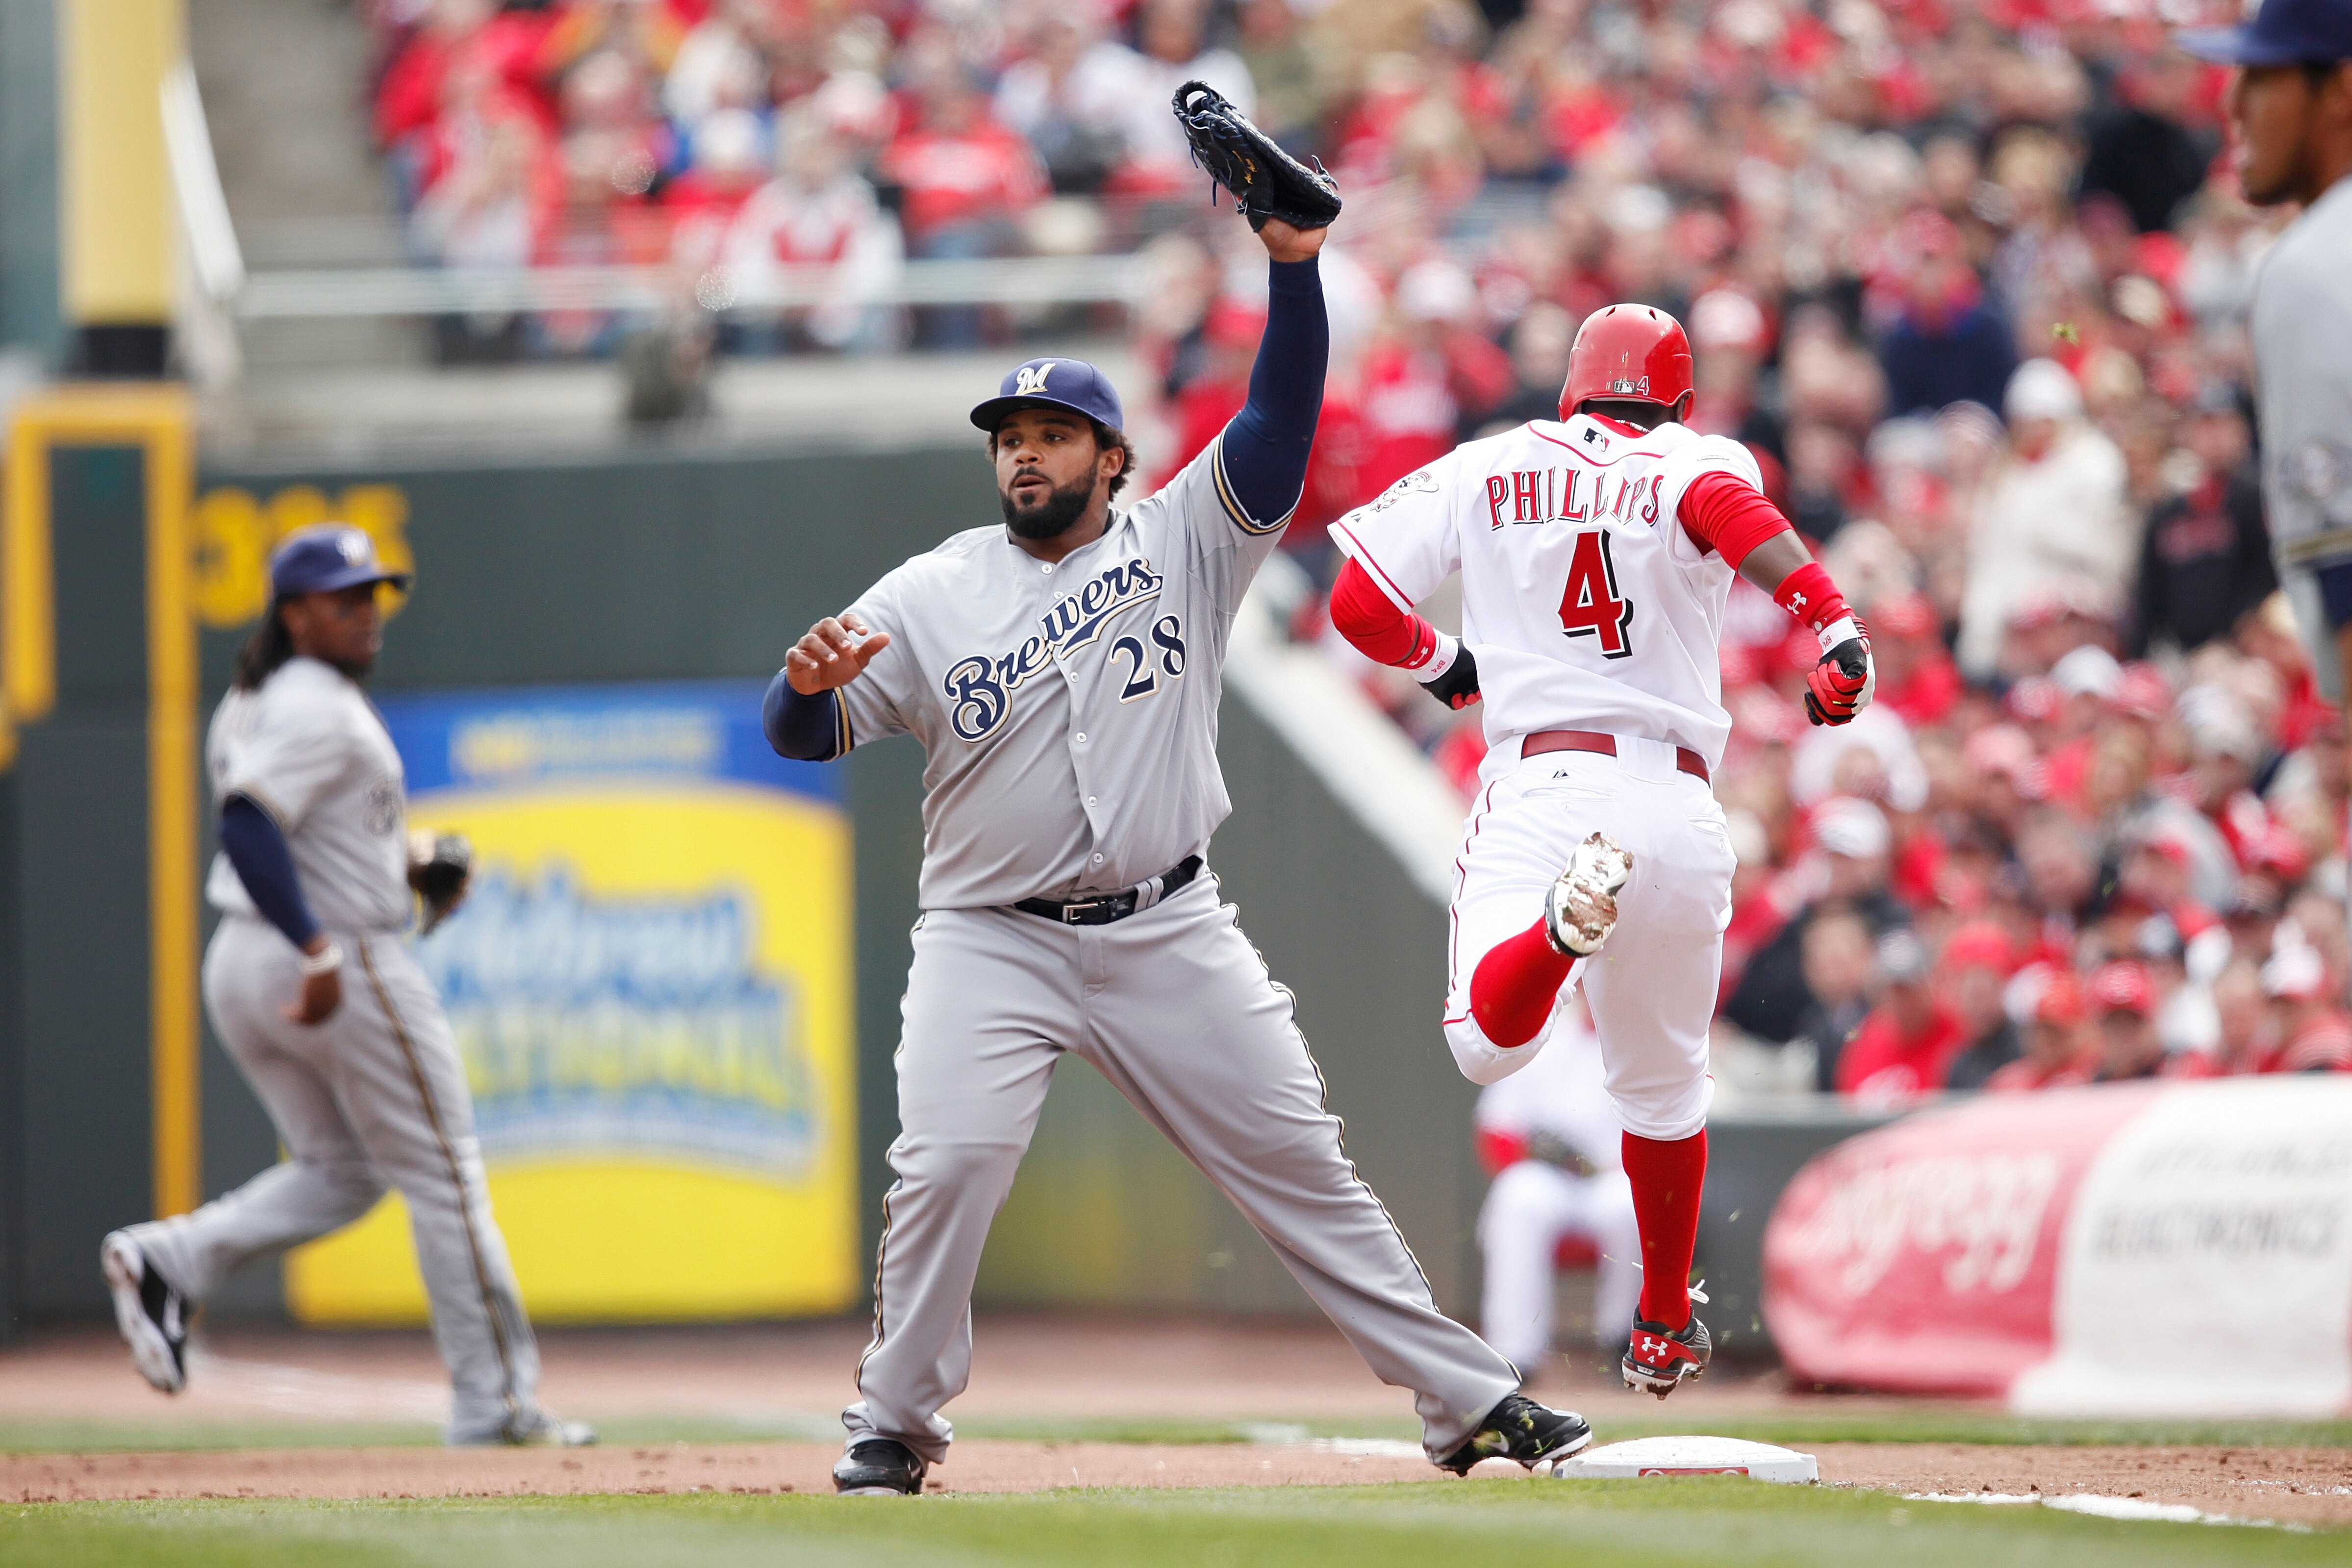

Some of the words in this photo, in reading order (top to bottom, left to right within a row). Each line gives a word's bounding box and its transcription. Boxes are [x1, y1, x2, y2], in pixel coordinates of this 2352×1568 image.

[1015, 362, 1056, 396] M
[1637, 376, 1649, 396] 4
[1486, 466, 1665, 531] PHILLIPS
[1555, 528, 1634, 660] 4
[943, 557, 1163, 743] Brewers
[1110, 613, 1187, 705] 28
[1431, 660, 1446, 673] BP4
